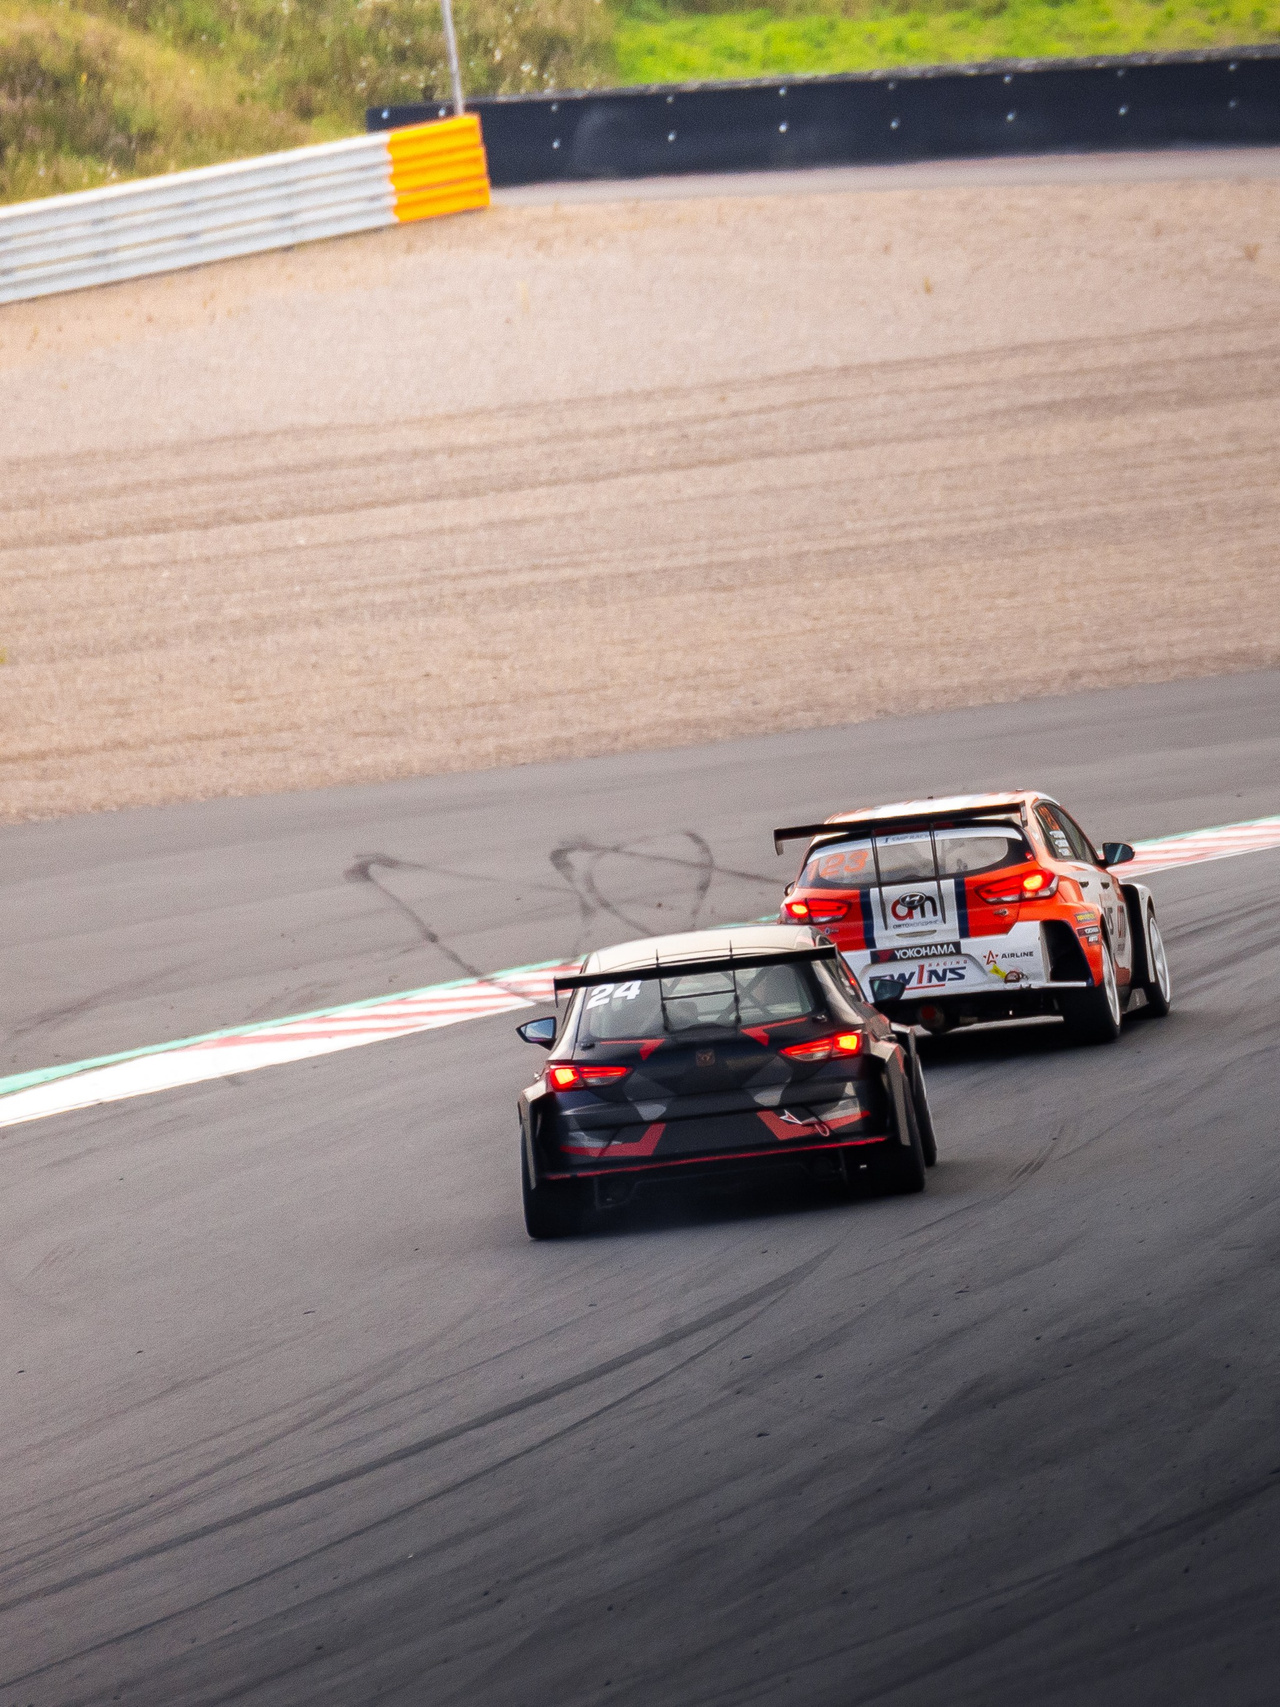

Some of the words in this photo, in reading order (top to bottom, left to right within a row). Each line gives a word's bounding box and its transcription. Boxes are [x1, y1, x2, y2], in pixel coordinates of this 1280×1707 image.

[895, 943, 956, 959] YOKOHAMA
[1001, 951, 1034, 960] AIRLINE
[586, 980, 642, 1010] 24
